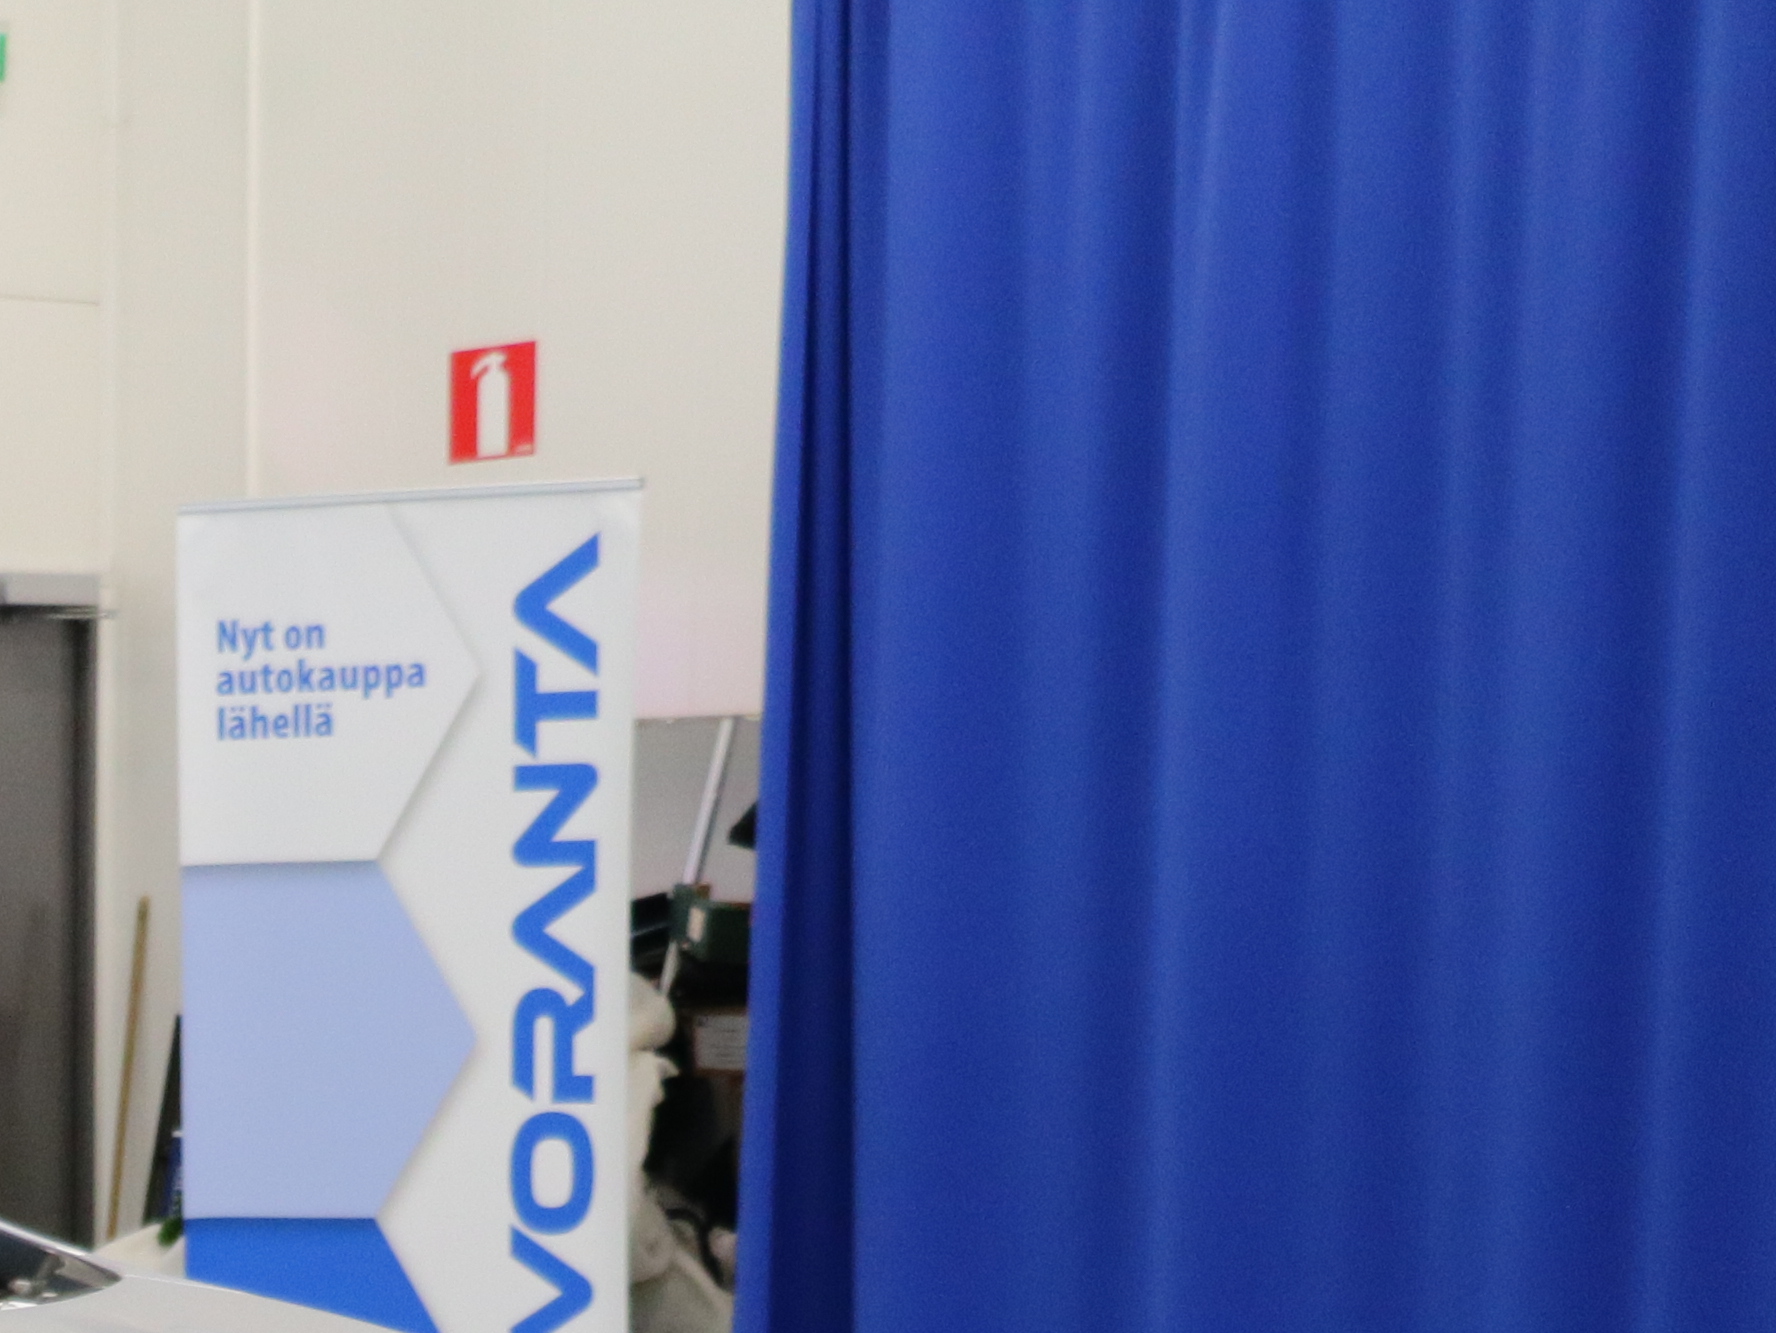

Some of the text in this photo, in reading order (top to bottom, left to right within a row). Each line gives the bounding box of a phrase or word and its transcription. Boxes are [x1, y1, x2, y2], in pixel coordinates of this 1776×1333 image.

[217, 620, 326, 661] Nyt on
[216, 658, 427, 700] autokauppa
[217, 702, 334, 740] lähellä
